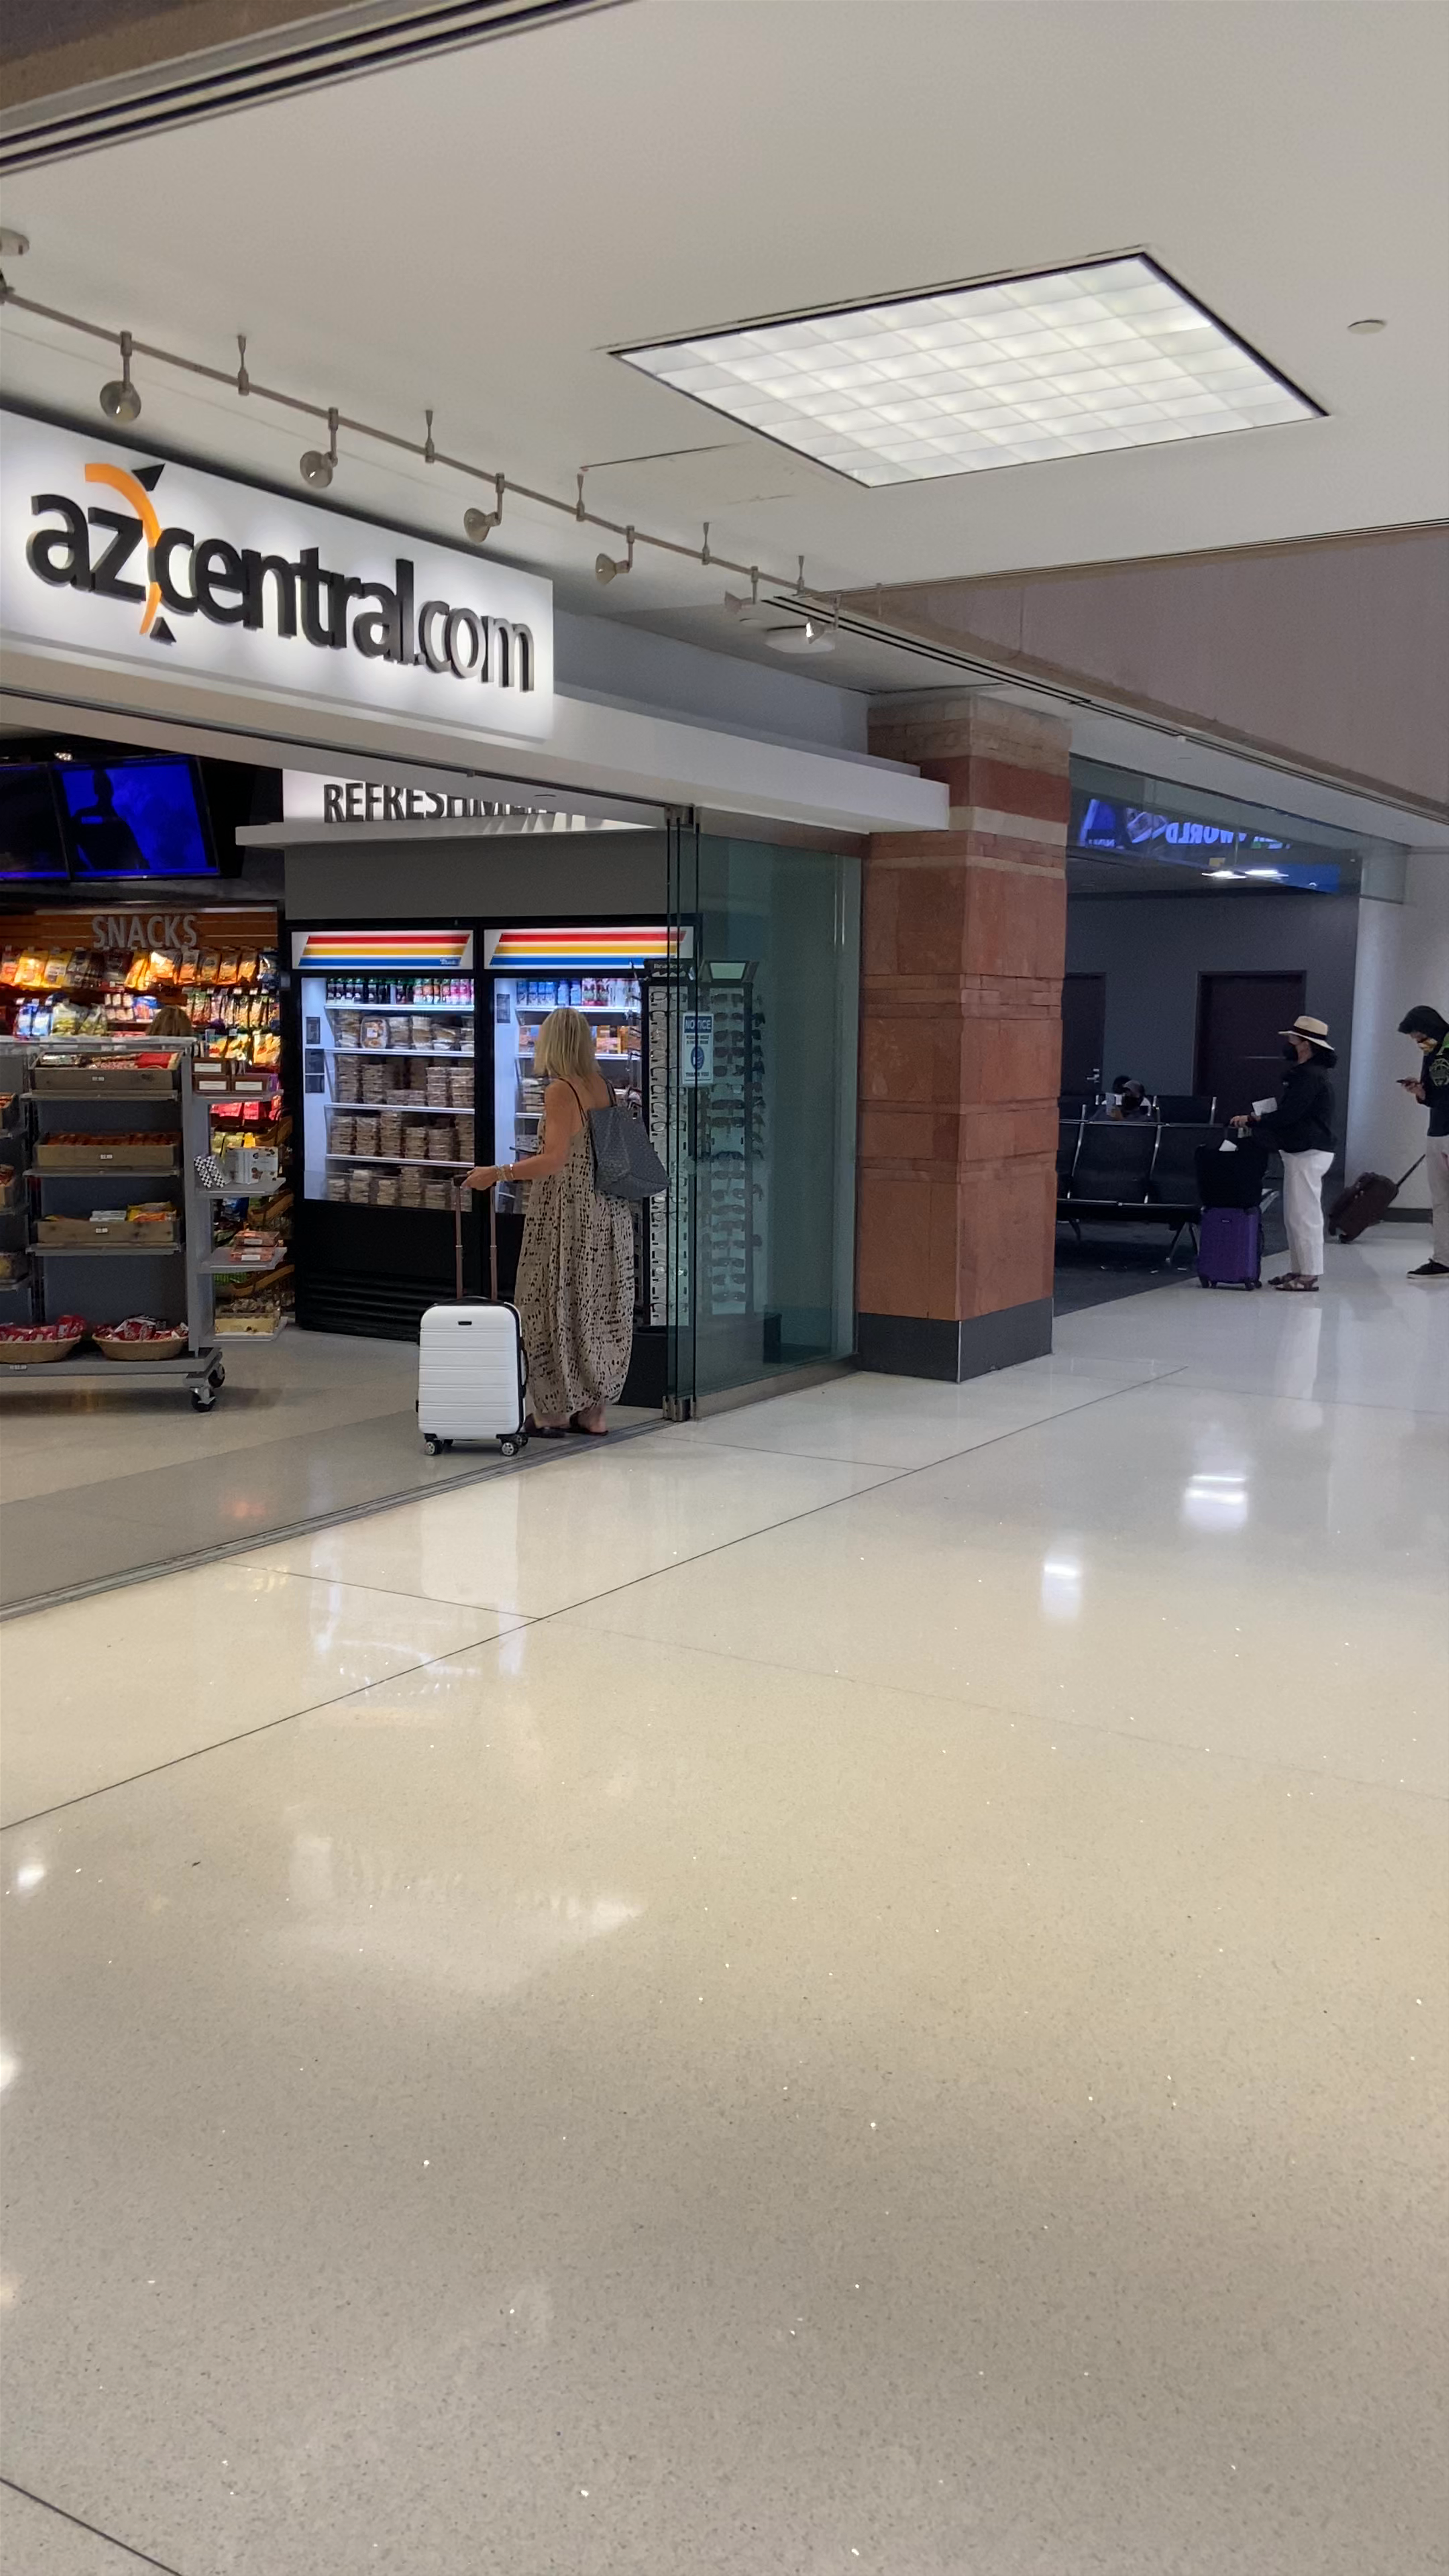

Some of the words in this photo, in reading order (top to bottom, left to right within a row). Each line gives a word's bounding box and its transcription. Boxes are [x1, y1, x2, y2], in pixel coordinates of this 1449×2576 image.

[26, 493, 534, 692] azcentral.com
[92, 914, 197, 948] SNACKS
[685, 1020, 712, 1030] NOTICE
